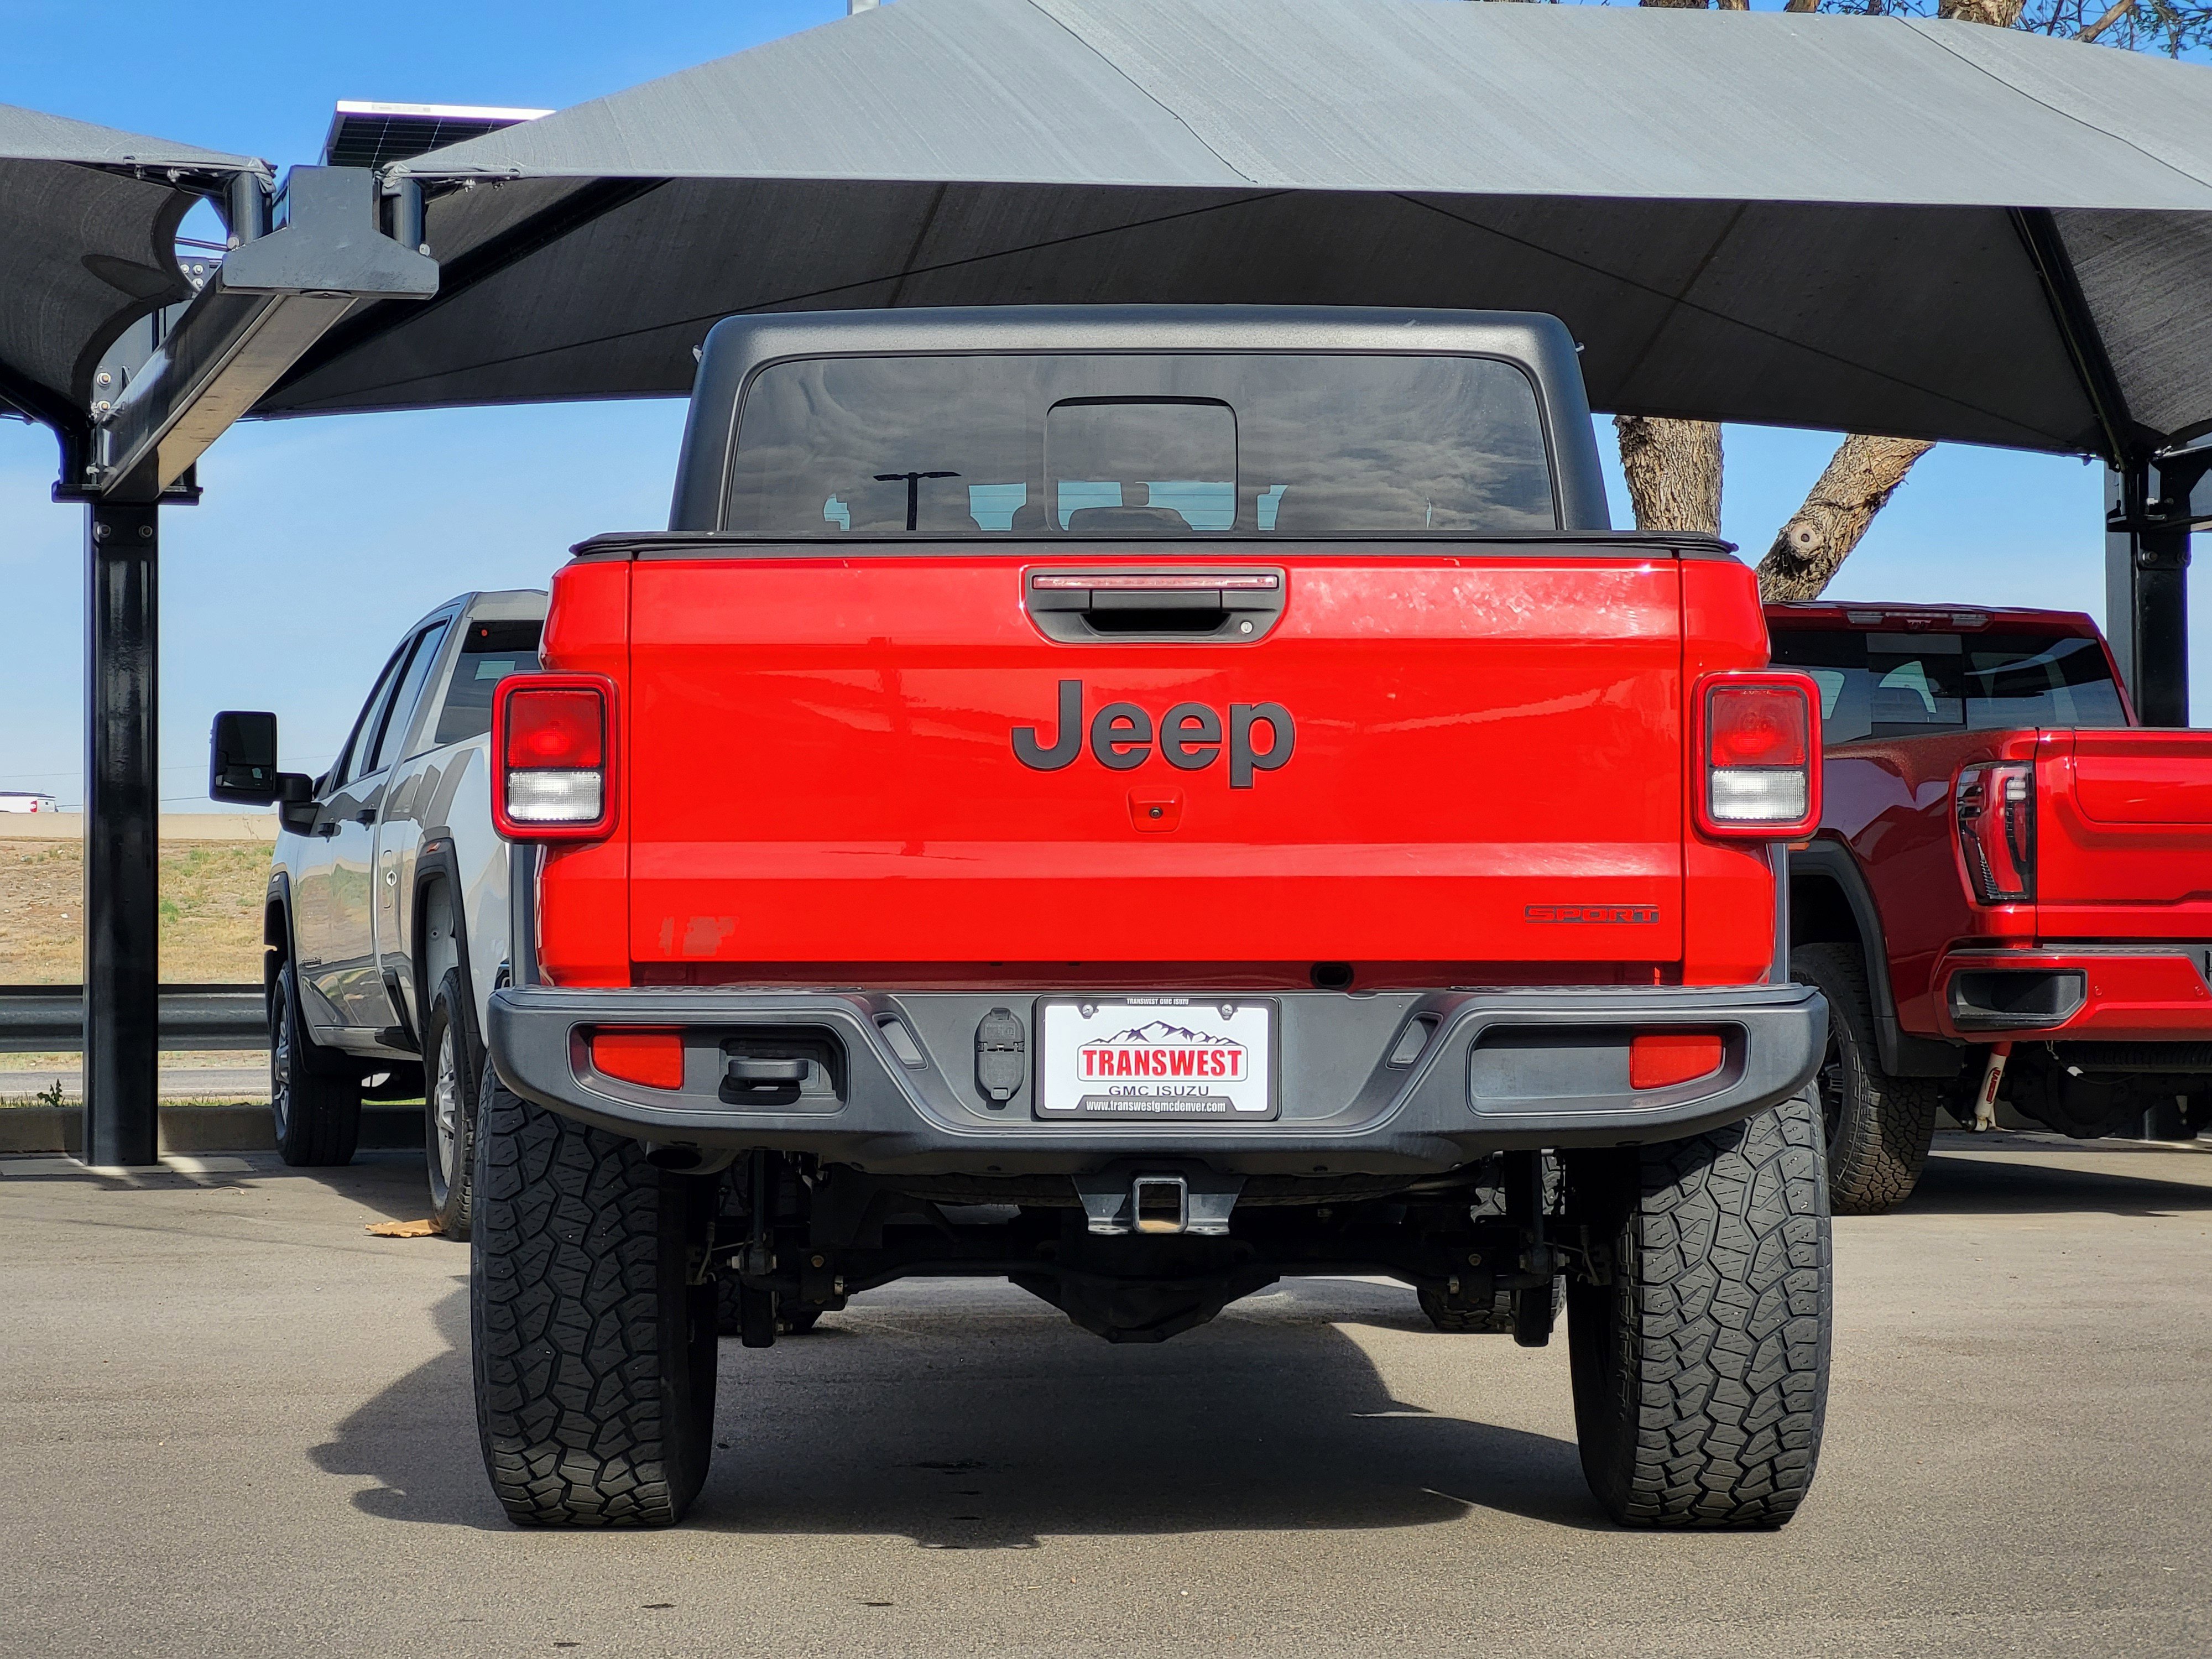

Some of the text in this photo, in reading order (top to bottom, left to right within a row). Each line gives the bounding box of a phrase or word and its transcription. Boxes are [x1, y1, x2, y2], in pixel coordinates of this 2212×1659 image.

[1011, 680, 1295, 789] Jeep
[1526, 907, 1659, 922] SPORT
[1083, 1050, 1241, 1076] TRANSWEST
[1109, 1086, 1209, 1096] GMC ISUZU
[1086, 1099, 1226, 1113] www.transwestgmcdenver.com
